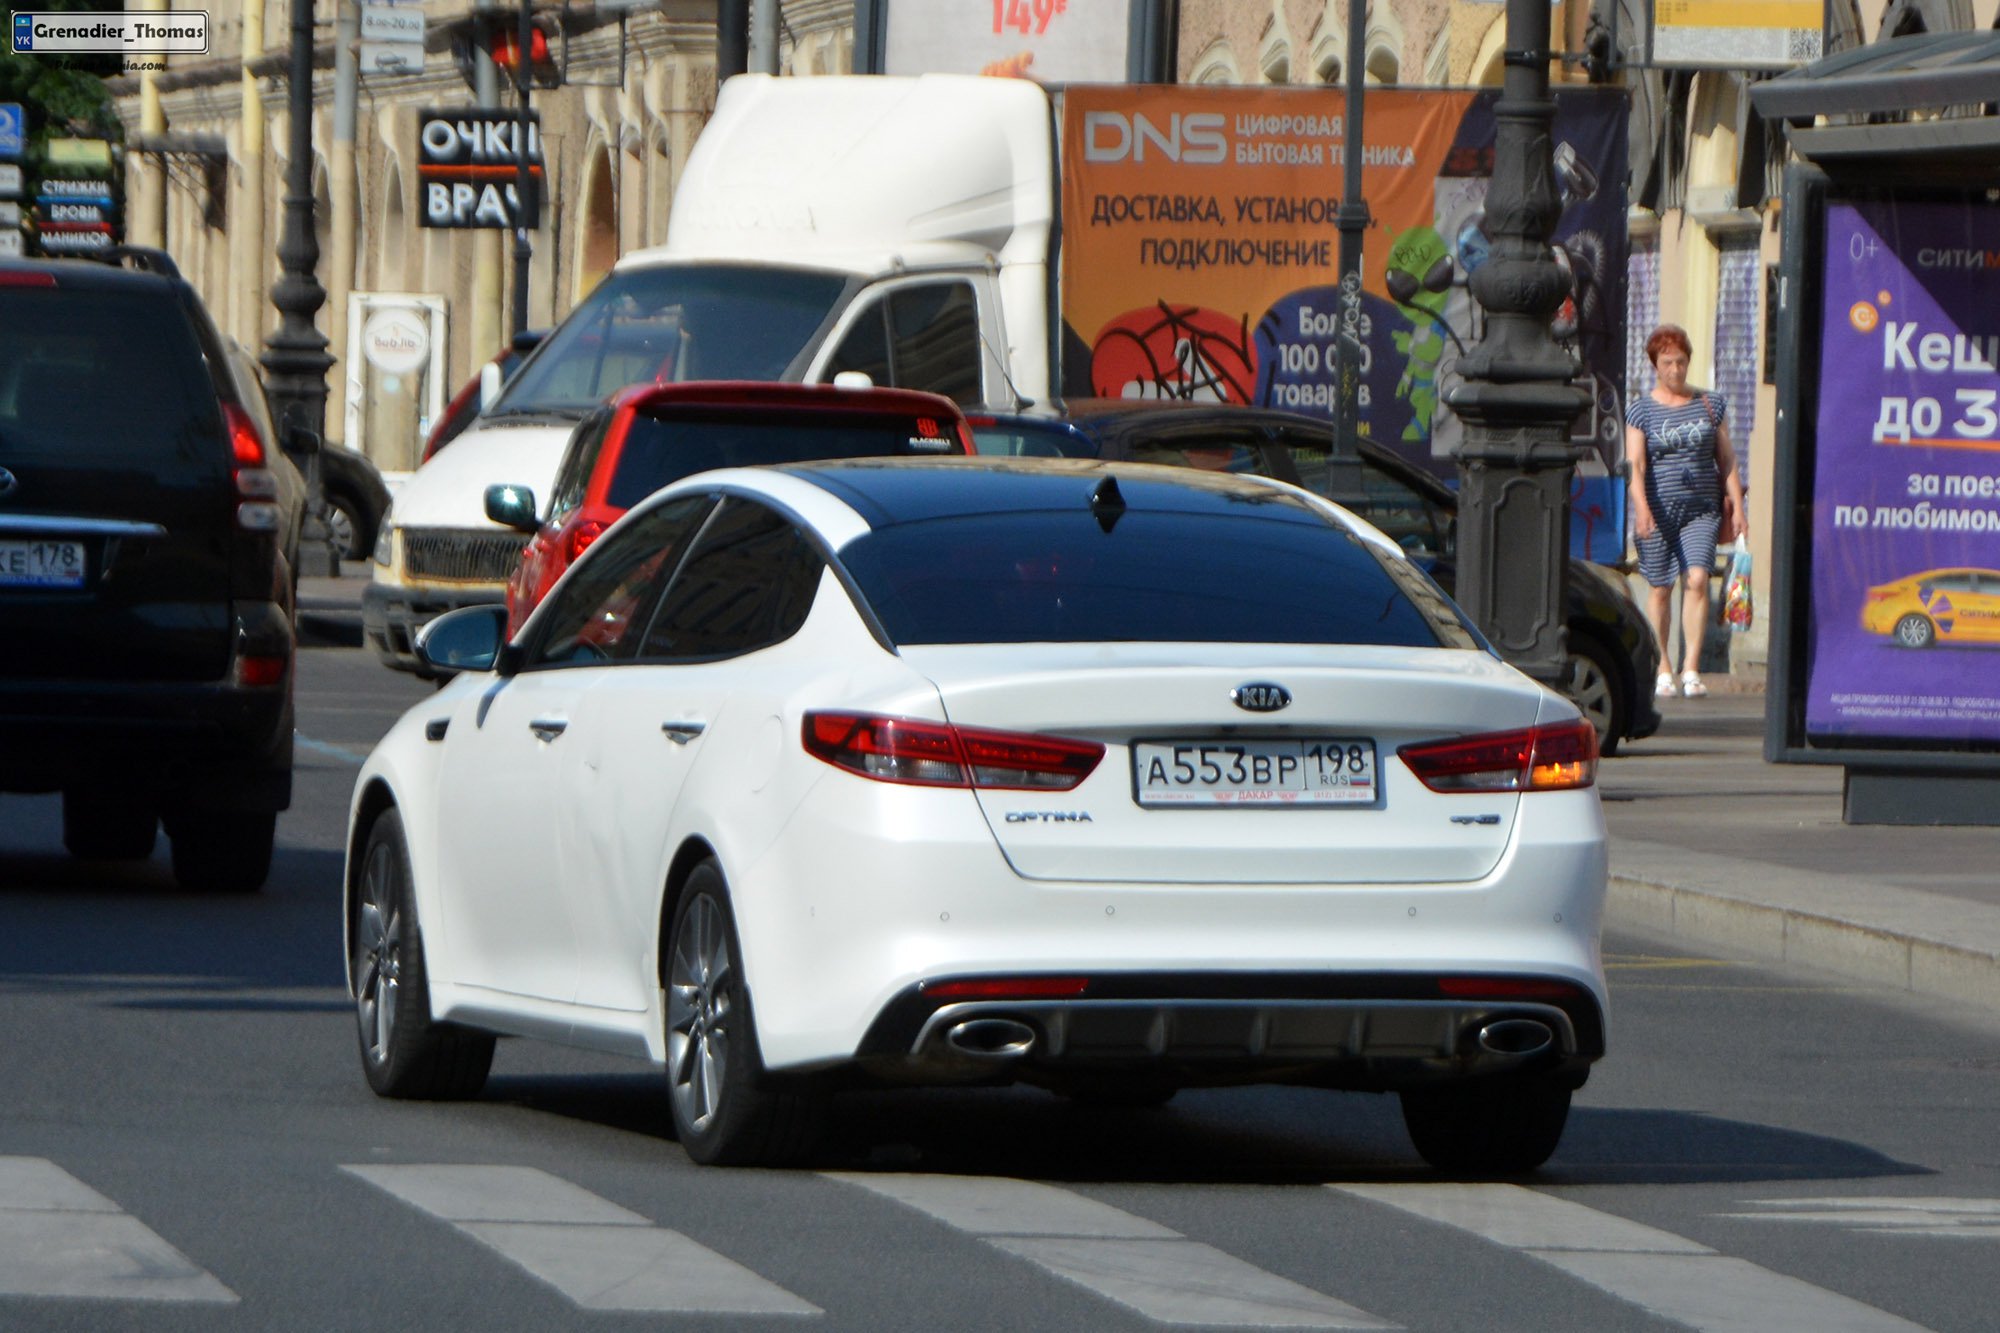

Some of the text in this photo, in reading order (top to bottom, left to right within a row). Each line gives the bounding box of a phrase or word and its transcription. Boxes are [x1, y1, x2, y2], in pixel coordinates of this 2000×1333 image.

[1235, 114, 1343, 136] ЦИФРОВАЯ
[1084, 111, 1228, 164] DNS
[1235, 143, 1323, 165] БЫТОВАЯ
[51, 204, 101, 220] БРОВИ
[1091, 195, 1226, 226] ДОСТАВКА,
[1140, 239, 1331, 270] ПОДКЛЮЧЕНИЕ
[1850, 232, 1879, 260] 0+
[1279, 344, 1372, 373] 100 00
[1873, 397, 1942, 442] до
[1907, 473, 1940, 495] за
[1834, 505, 1868, 527] по
[33, 544, 75, 566] 178
[1242, 687, 1283, 706] KIA
[1308, 744, 1366, 773] 198
[1320, 774, 1348, 785] RUS
[1238, 790, 1274, 800] ДАКАР
[1005, 811, 1093, 822] OPTIMA
